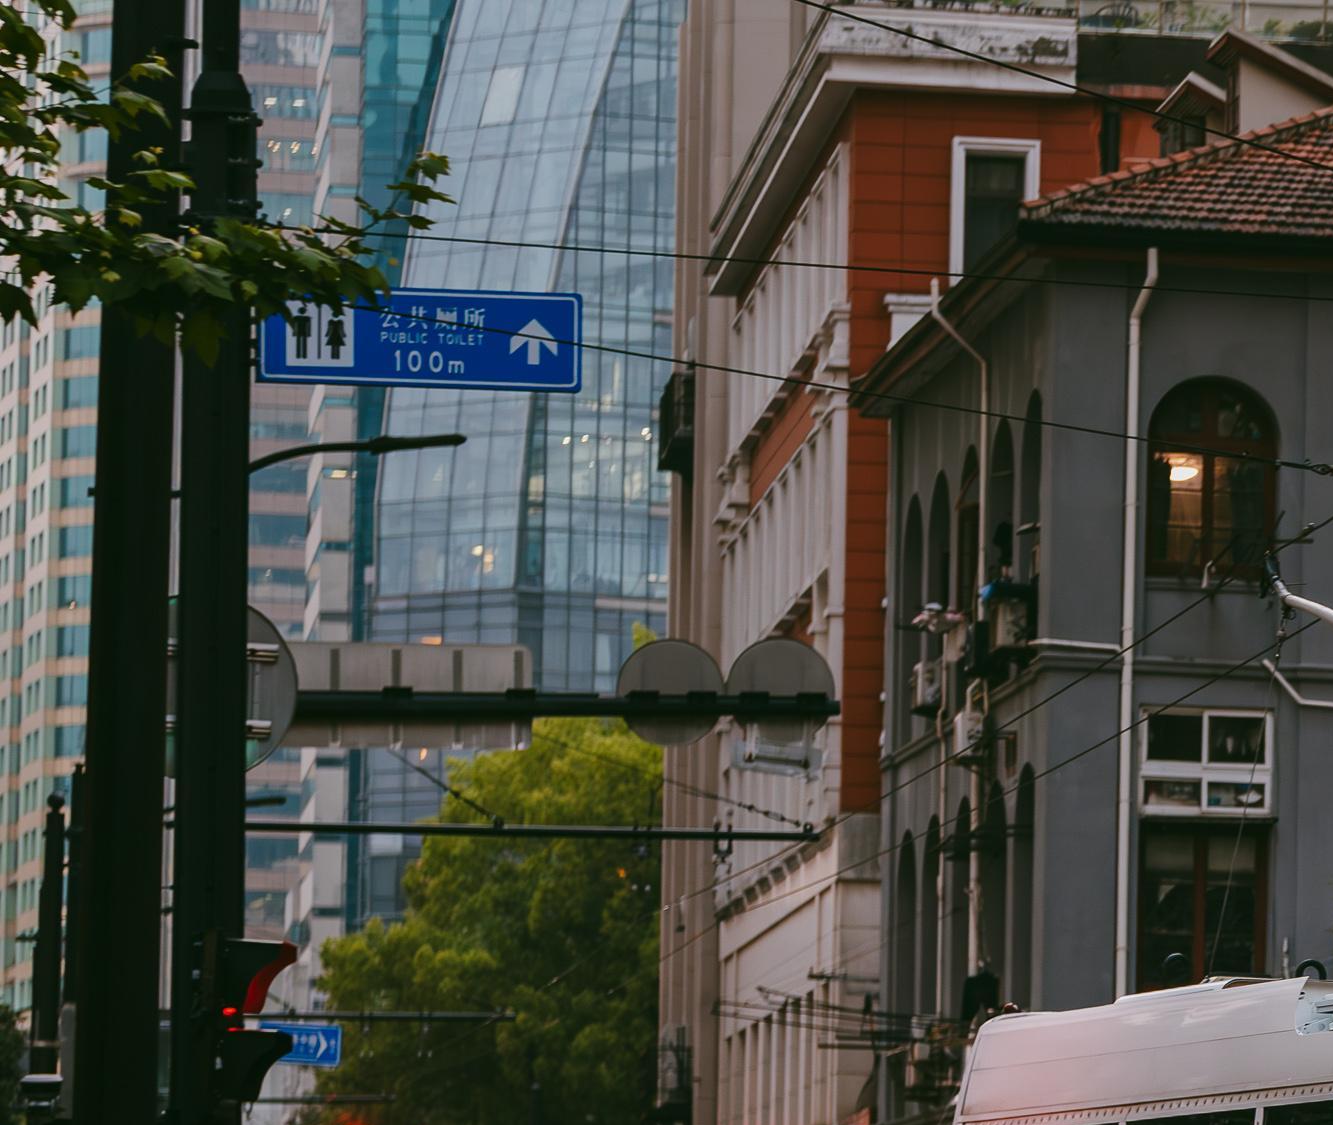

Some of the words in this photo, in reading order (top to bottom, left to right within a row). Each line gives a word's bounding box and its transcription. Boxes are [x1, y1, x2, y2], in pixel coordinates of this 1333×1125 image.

[380, 331, 428, 344] PUBLIC
[438, 333, 484, 346] TOILET
[394, 349, 465, 374] 100m
